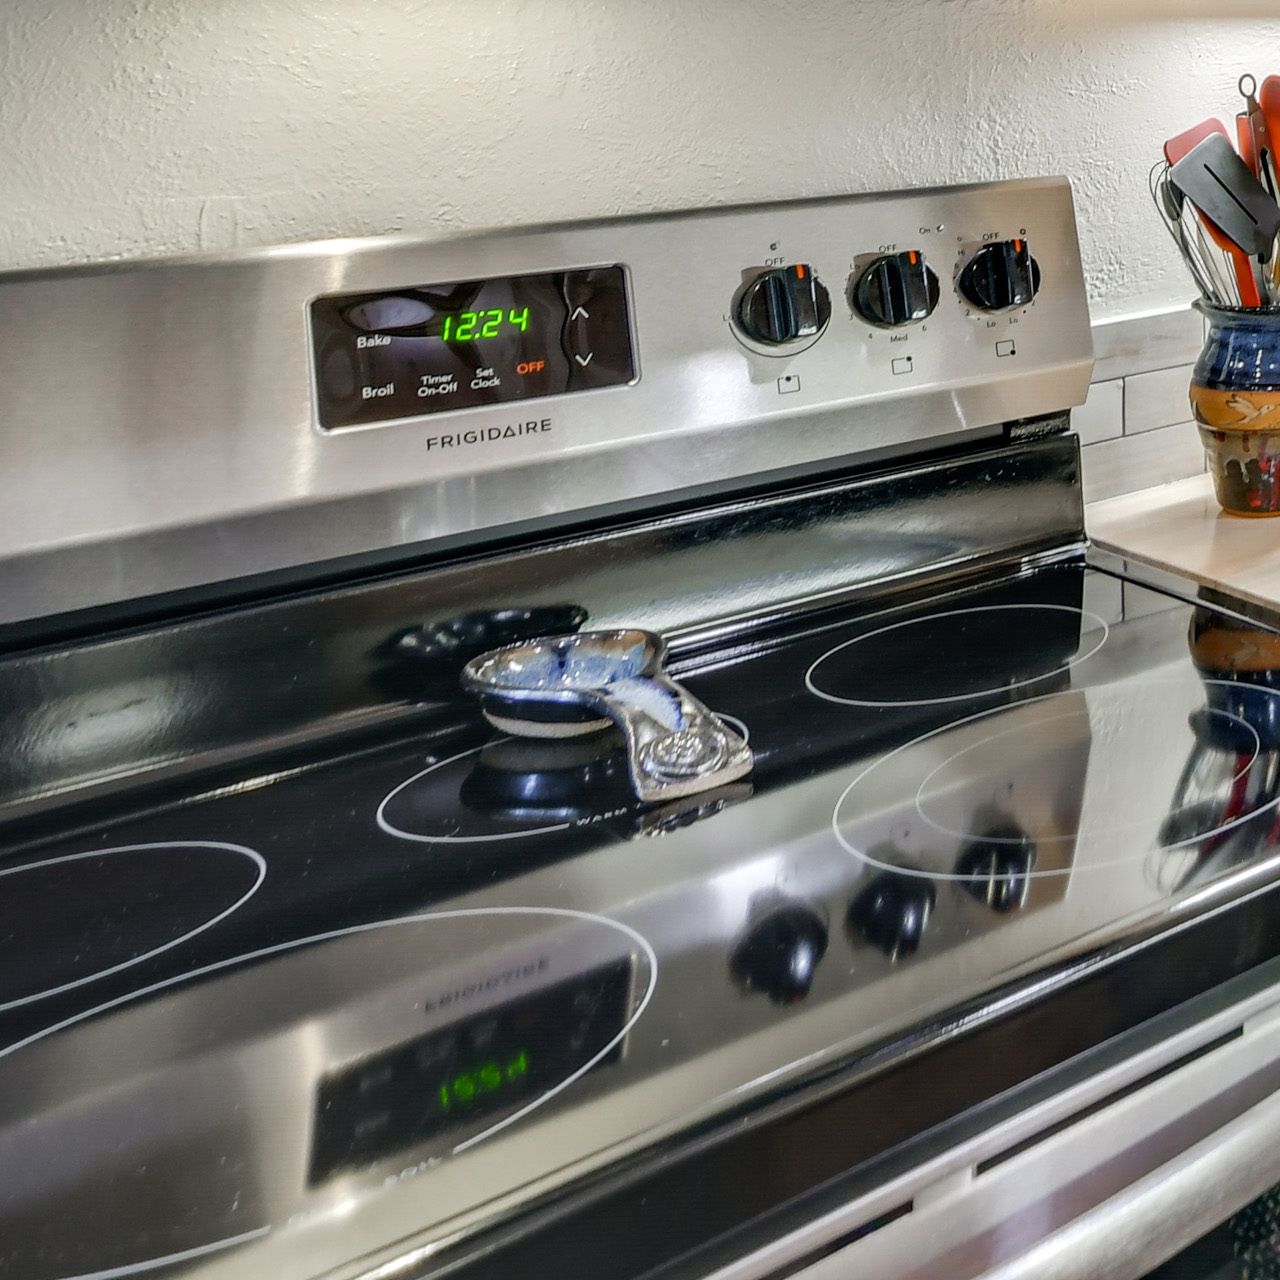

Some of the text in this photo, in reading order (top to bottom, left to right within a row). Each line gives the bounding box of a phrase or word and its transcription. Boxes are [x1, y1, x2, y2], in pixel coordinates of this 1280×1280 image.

[982, 232, 1000, 241] OFF
[878, 244, 897, 253] OFF
[765, 256, 785, 266] OFF
[442, 307, 529, 342] 12:24
[357, 334, 392, 349] Bake
[890, 333, 908, 343] Med
[476, 367, 494, 378] Set
[516, 360, 545, 375] OFF
[421, 373, 454, 386] Timer
[470, 376, 501, 390] Clock
[362, 383, 395, 400] Broil
[417, 381, 458, 397] On-Off
[426, 418, 552, 451] FRIGIDAIRE
